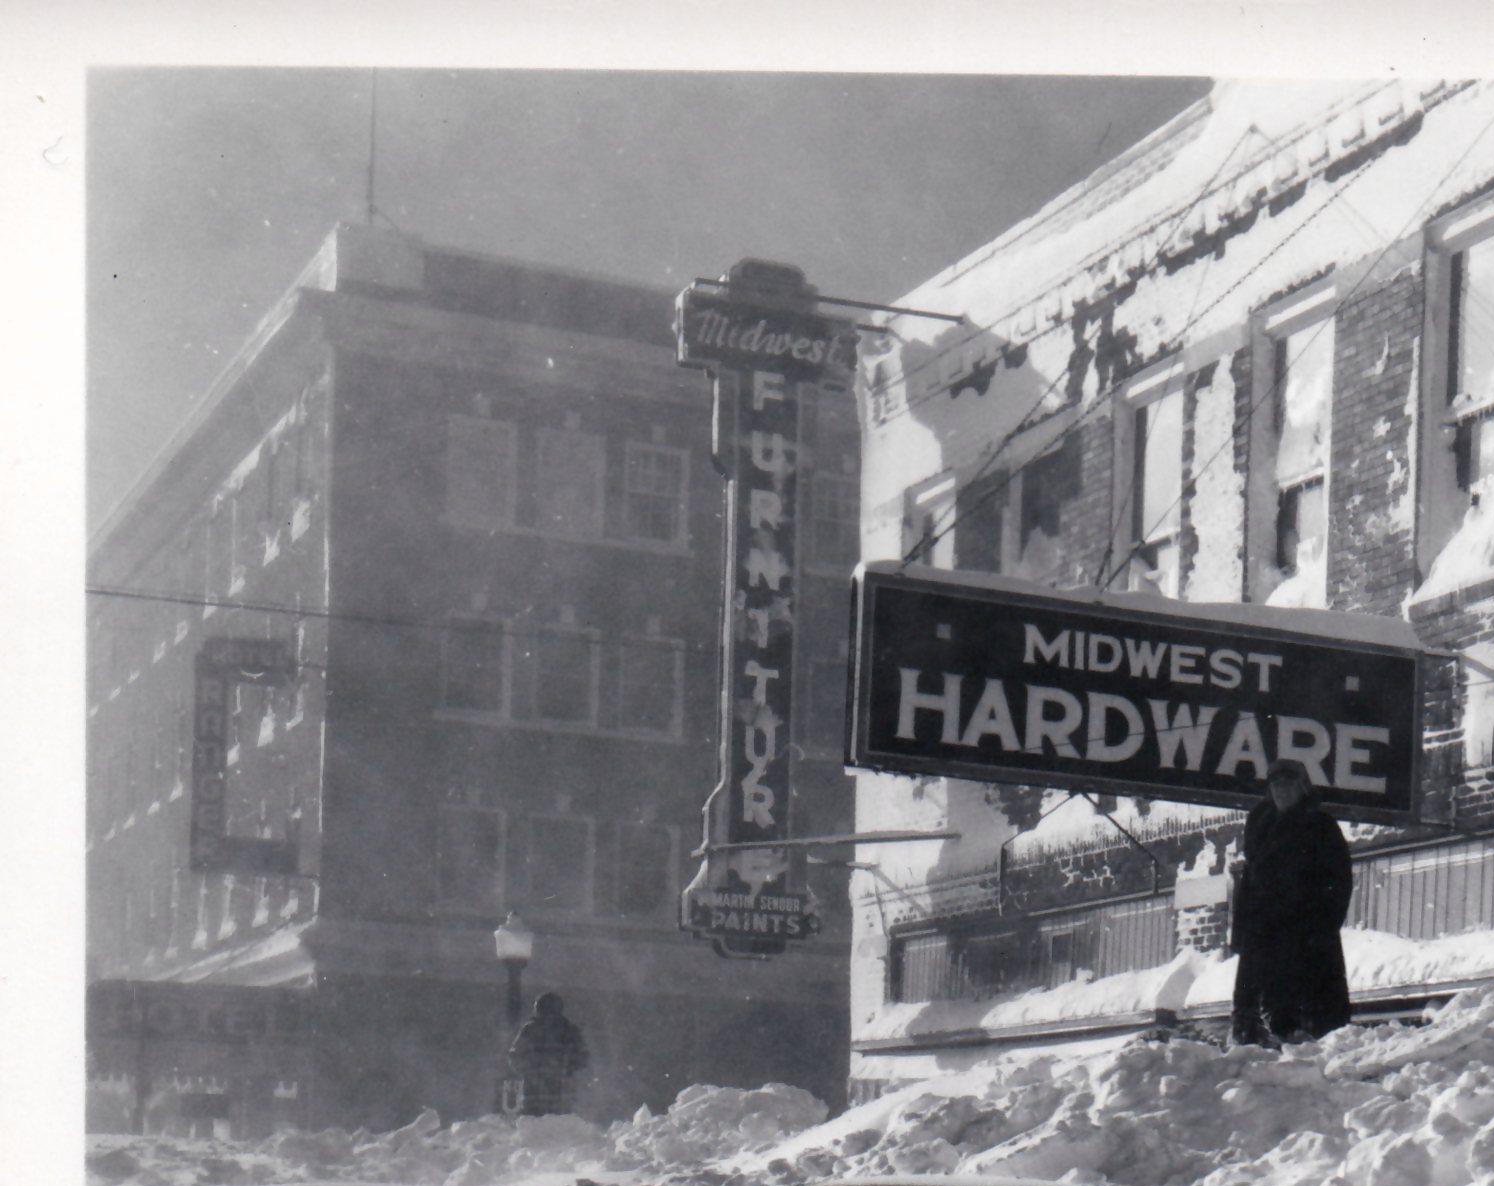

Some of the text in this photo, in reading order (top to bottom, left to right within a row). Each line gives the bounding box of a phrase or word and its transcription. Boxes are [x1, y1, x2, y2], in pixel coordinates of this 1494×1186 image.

[697, 308, 842, 364] Midwest
[1022, 623, 1283, 692] MIDWEST
[894, 667, 1390, 794] HARDWARE
[711, 910, 801, 935] PAINTS
